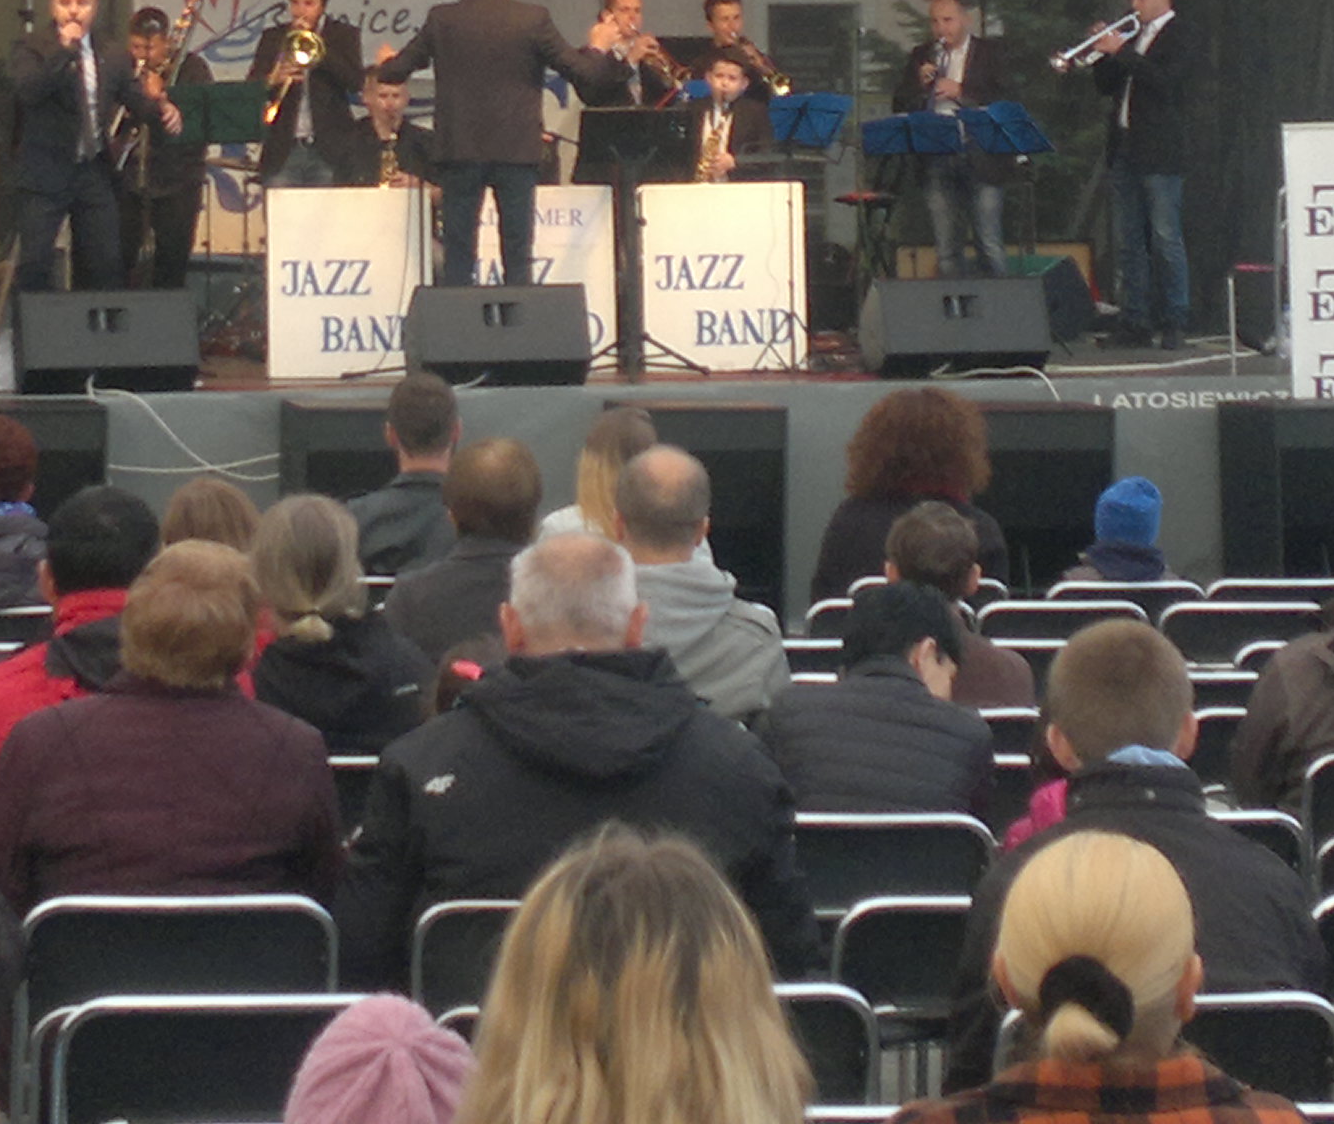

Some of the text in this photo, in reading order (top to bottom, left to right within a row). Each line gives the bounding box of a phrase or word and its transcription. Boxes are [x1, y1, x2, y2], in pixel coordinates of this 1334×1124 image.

[280, 259, 372, 297] JAZZ
[654, 254, 745, 291] JAZZ
[320, 314, 406, 353] BAN
[694, 308, 793, 346] BAND
